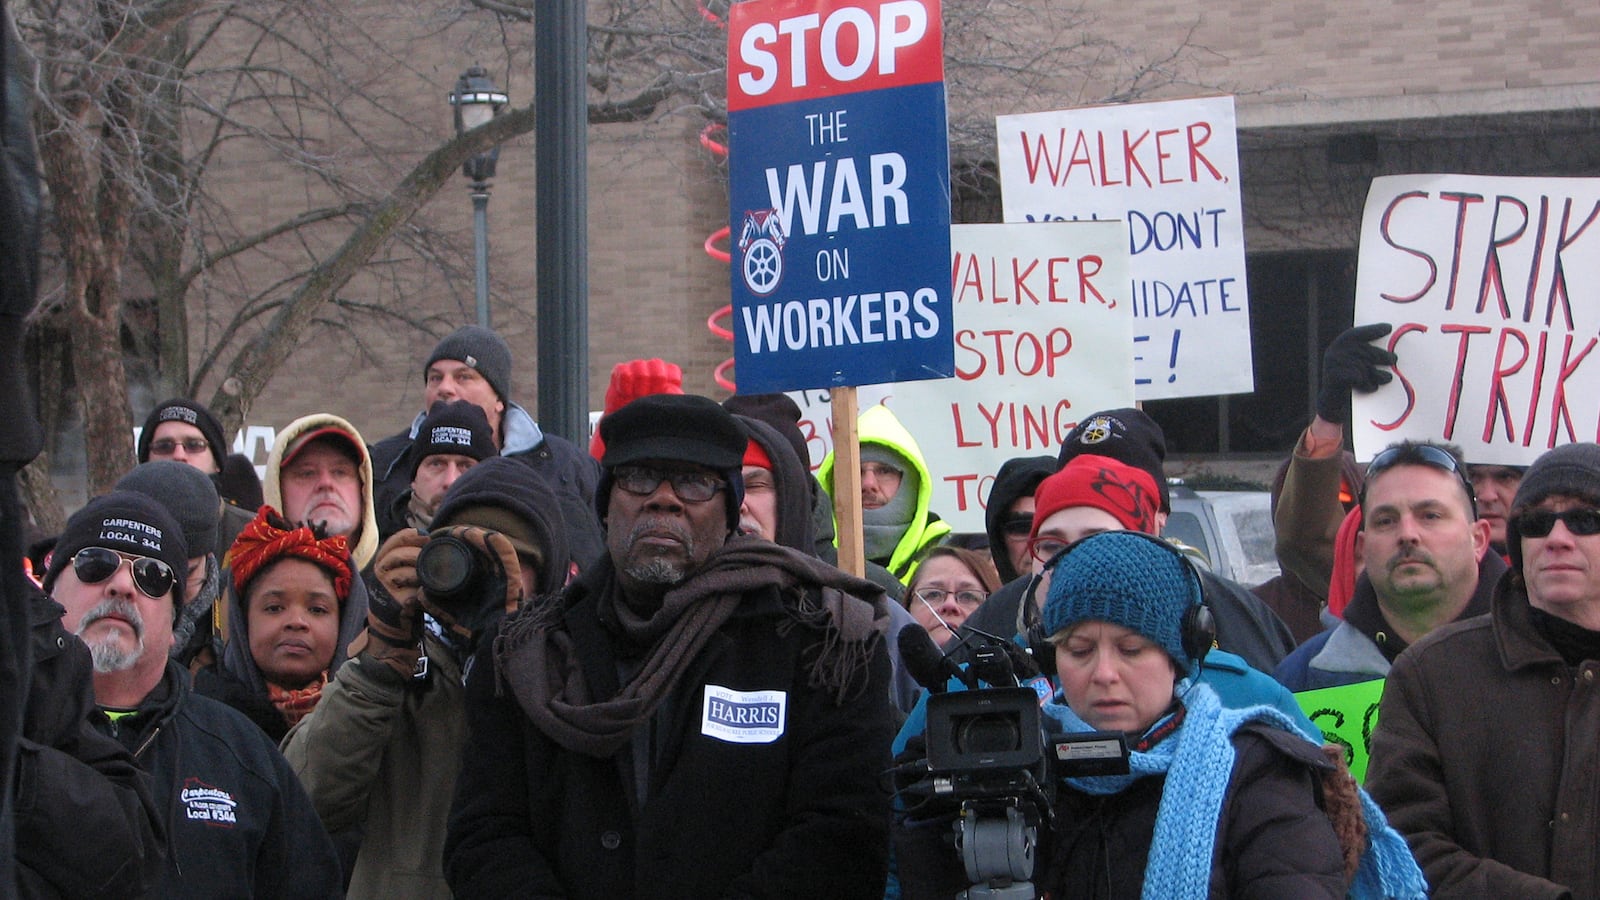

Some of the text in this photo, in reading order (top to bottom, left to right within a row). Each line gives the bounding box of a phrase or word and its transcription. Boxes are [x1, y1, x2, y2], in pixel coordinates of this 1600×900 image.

[738, 0, 927, 96] STOP
[805, 110, 848, 146] THE
[1020, 121, 1229, 188] WALKER,
[765, 152, 910, 238] WAR
[1127, 207, 1227, 255] DON'T
[816, 248, 849, 281] ON
[951, 251, 1117, 309] ALKER,
[1380, 190, 1600, 332] STRIK
[742, 287, 940, 354] WORKERS
[955, 327, 1072, 380] STOP
[1370, 323, 1600, 450] STRIK
[432, 426, 471, 436] CARPENTERS
[951, 398, 1077, 450] LYING
[99, 531, 162, 551] LOCAL 344
[102, 518, 162, 539] CARPENTERS
[711, 701, 777, 724] HARRIS
[715, 690, 733, 700] VOTE
[181, 788, 233, 804] Carpenters
[187, 808, 236, 822] Local #344
